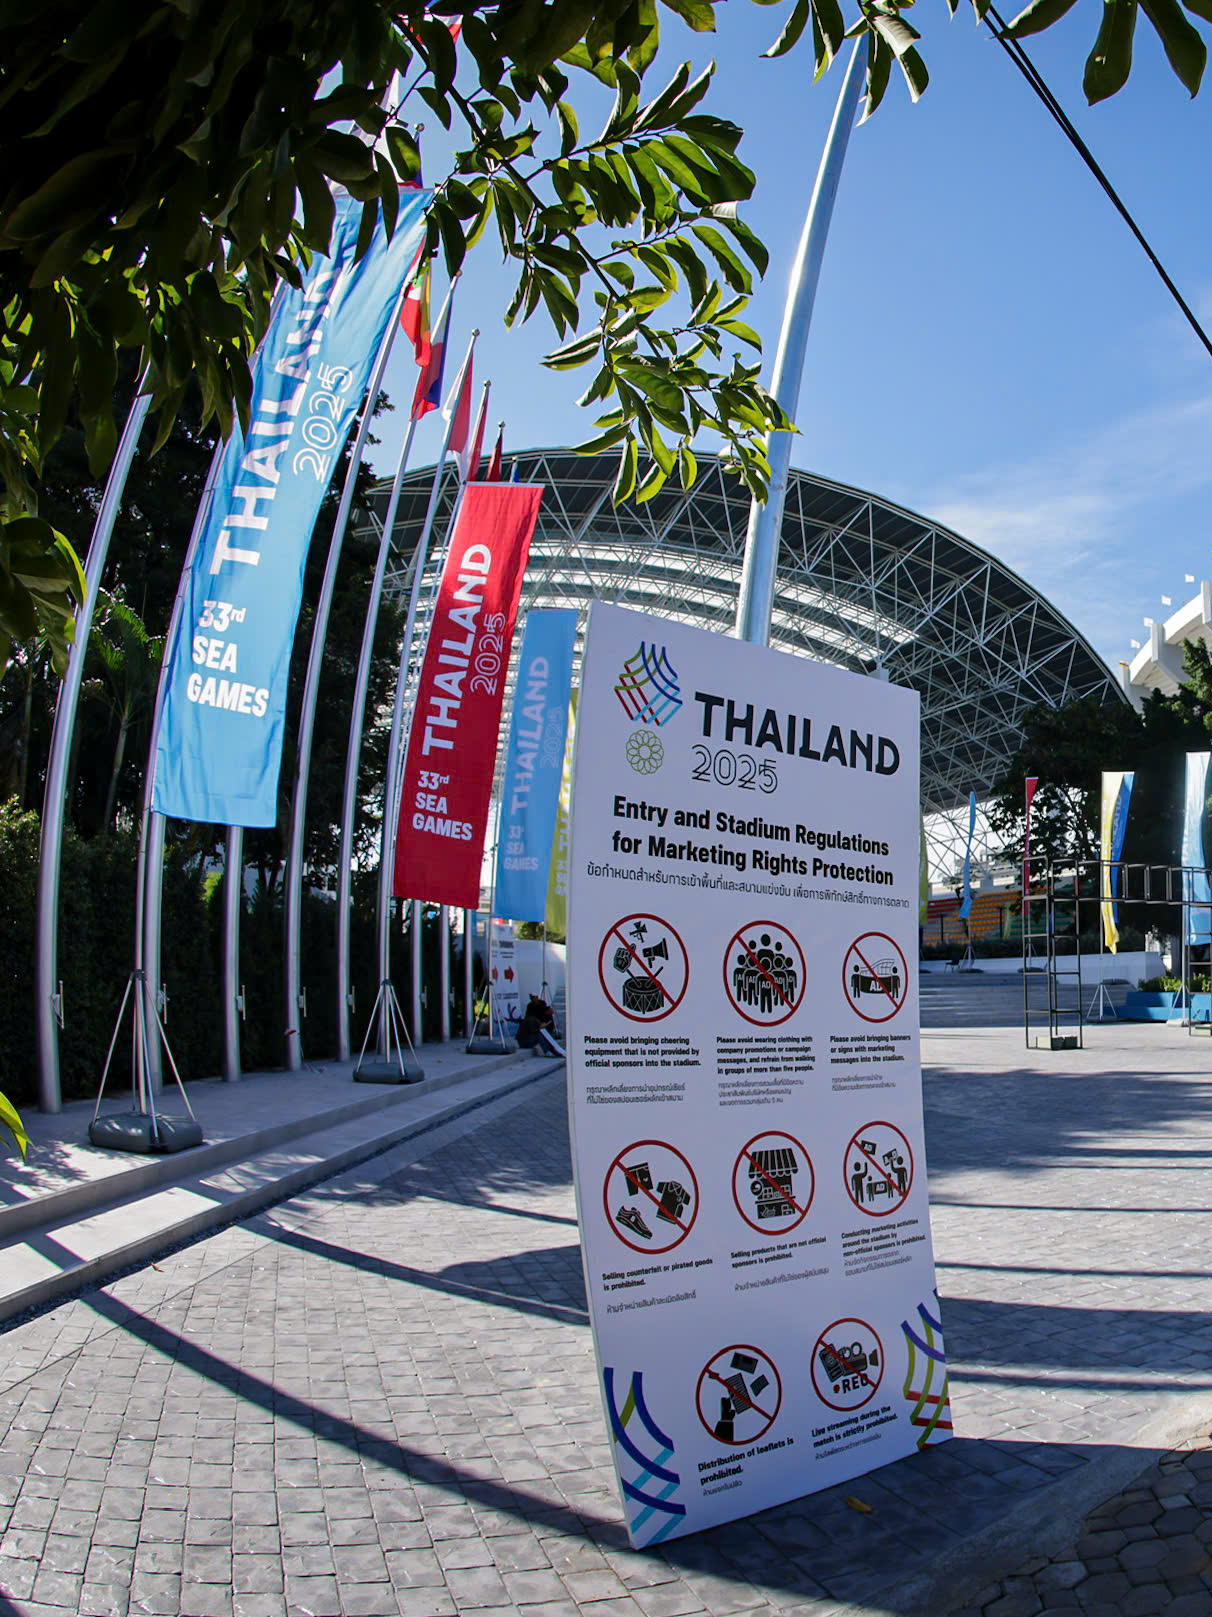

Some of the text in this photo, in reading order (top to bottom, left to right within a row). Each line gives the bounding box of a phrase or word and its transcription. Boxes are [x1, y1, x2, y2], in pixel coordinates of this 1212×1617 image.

[292, 361, 354, 484] 2025
[197, 599, 247, 633] 33rd
[192, 635, 238, 674] SEA
[421, 542, 493, 757] THAILAND
[469, 611, 507, 698] 2025
[186, 678, 270, 718] GAMES
[511, 655, 550, 817] THAILAND
[540, 705, 565, 769] 2025
[694, 690, 901, 776] THAILAND
[691, 744, 779, 794] 2025
[417, 770, 450, 791] 33rd
[414, 792, 448, 815] SEA
[412, 812, 473, 842] GAMES
[613, 795, 889, 856] Entry and Stadium Regulations
[612, 830, 894, 885] for Marketing Rights Protection
[584, 1035, 690, 1046] Please avoid bringing cheering
[755, 1036, 777, 1044] wearing
[778, 1035, 800, 1044] clothing
[801, 1035, 813, 1043] with
[851, 1034, 866, 1042] avoid
[867, 1034, 889, 1042] bringing
[890, 1033, 911, 1041] banners
[584, 1048, 700, 1057] equipment that is not provided by
[716, 1047, 744, 1056] company
[745, 1046, 777, 1054] promotions
[785, 1045, 812, 1054] campaign
[717, 1054, 815, 1065] messages, and refrain from walking
[838, 1046, 853, 1054] signs
[868, 1044, 896, 1052] marketing
[585, 1058, 702, 1069] official sponsors into the stadium.
[725, 1067, 745, 1075] groups
[746, 1065, 752, 1073] of
[795, 1064, 815, 1073] people.
[841, 1229, 870, 1239] Conducting
[871, 1223, 896, 1233] marketing
[842, 1240, 860, 1248] around
[870, 1233, 890, 1242] stadium
[731, 1250, 750, 1258] Selling
[752, 1246, 775, 1256] products
[808, 1236, 827, 1245] official
[874, 1241, 896, 1251] sponsors
[602, 1272, 625, 1280] Selling
[626, 1265, 662, 1277] counterfeit
[671, 1260, 693, 1271] pirated
[695, 1258, 713, 1267] goods
[732, 1259, 757, 1268] sponsors
[765, 1252, 793, 1263] prohibited.
[603, 1279, 646, 1291] is prohibited.
[842, 1373, 868, 1394] REC
[811, 1405, 891, 1438] Live streaming during the
[813, 1436, 834, 1448] match
[843, 1425, 865, 1438] strictly
[698, 1437, 794, 1472] Distribution of leaflets is
[700, 1464, 744, 1486] prohibited.
